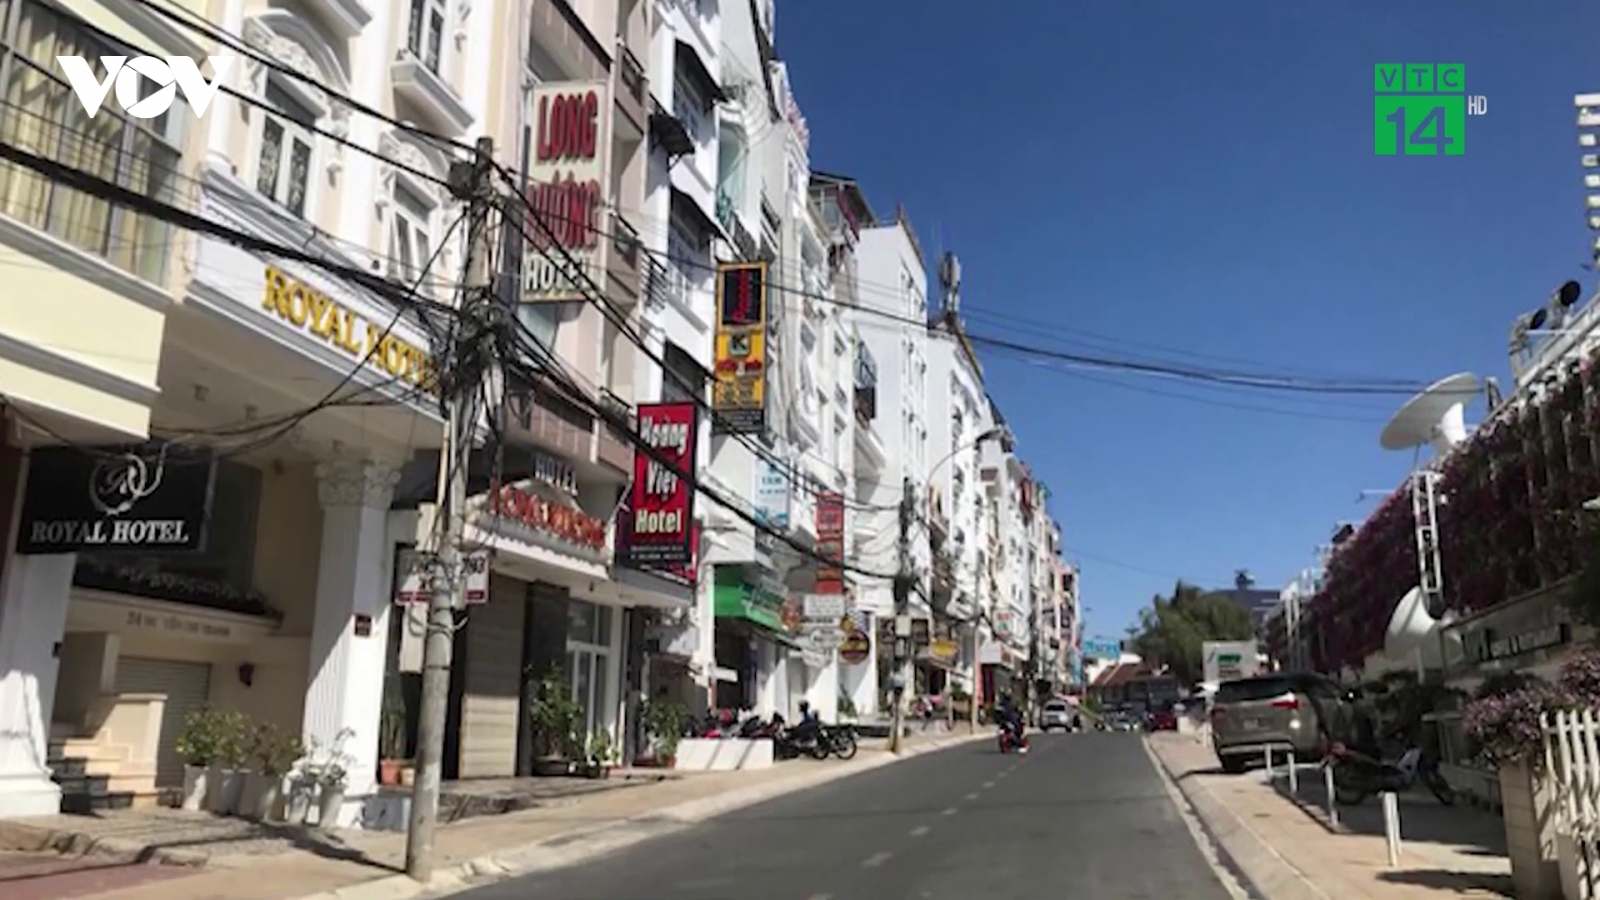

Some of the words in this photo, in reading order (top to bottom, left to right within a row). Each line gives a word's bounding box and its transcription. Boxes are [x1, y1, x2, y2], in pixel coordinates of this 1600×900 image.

[535, 90, 598, 163] LONG
[262, 266, 361, 356] ROYAL
[31, 520, 107, 543] ROYAL
[110, 520, 189, 543] HOTEL
[635, 509, 682, 534] Hotel
